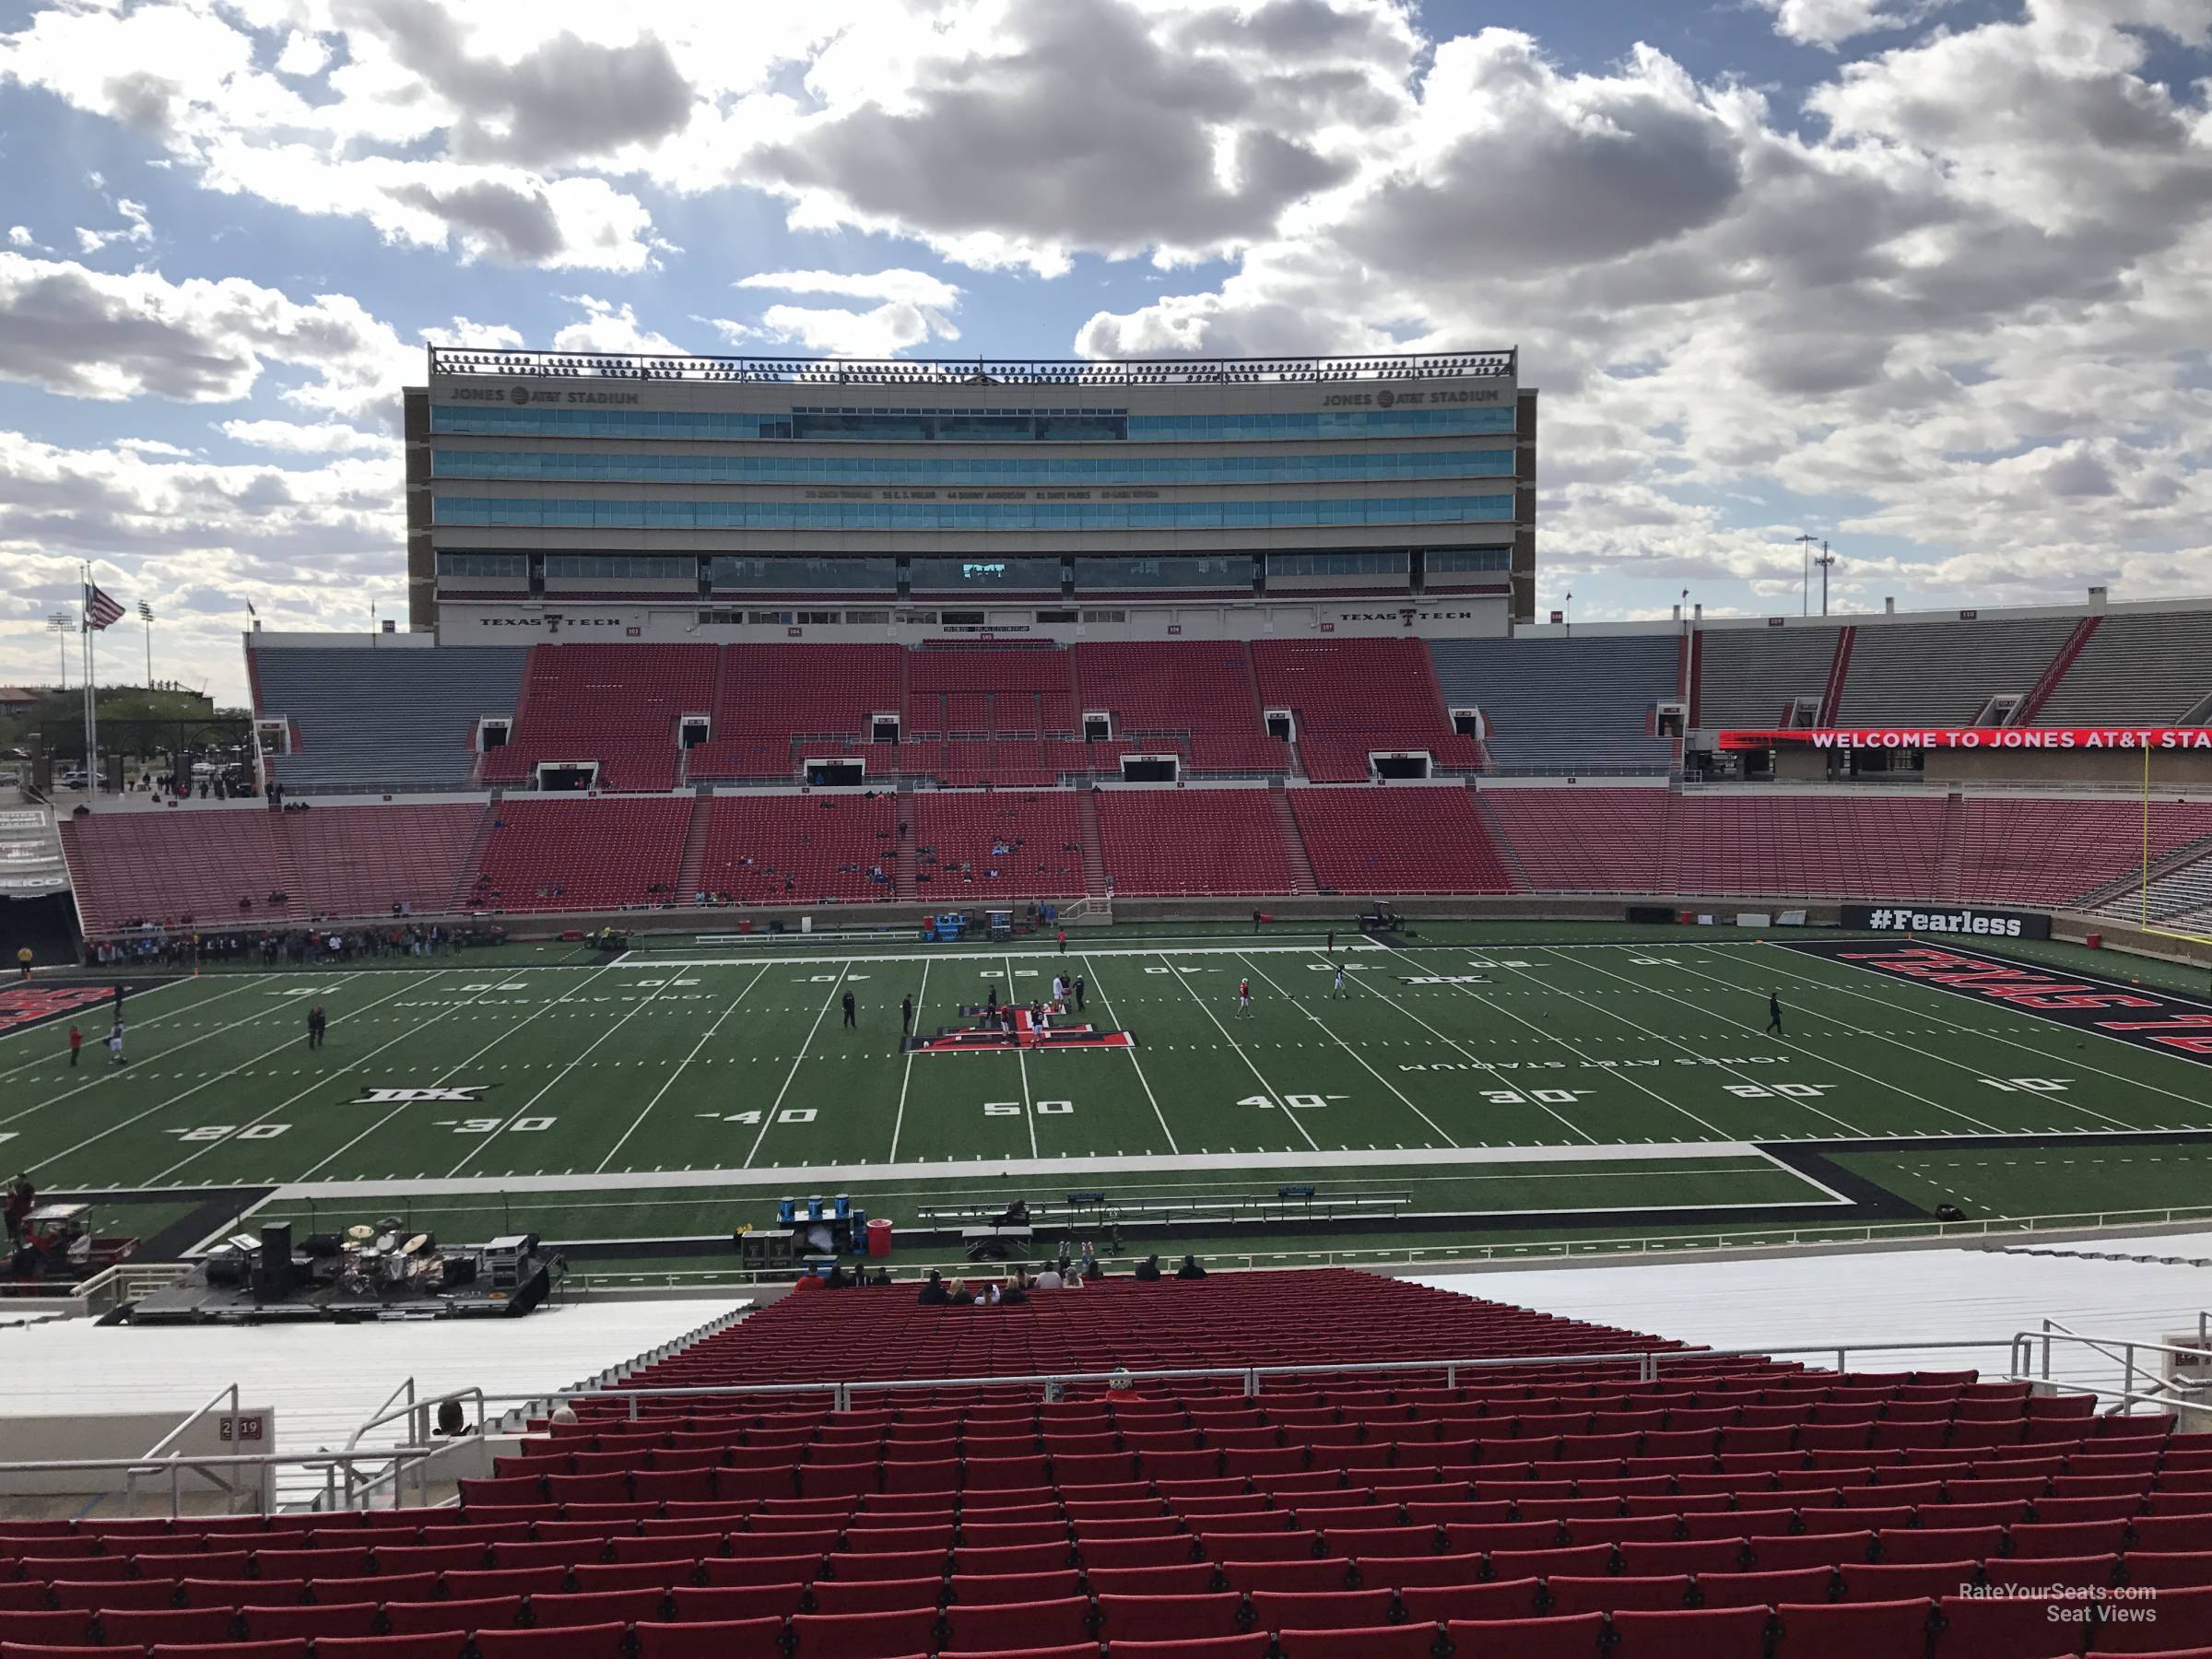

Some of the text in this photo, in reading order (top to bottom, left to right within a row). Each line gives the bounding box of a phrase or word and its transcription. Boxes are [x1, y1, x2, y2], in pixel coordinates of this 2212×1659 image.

[451, 388, 504, 401] JONES
[568, 391, 639, 405] STADIUM
[1323, 394, 1371, 406] JONES
[1430, 390, 1498, 403] STADIUM
[1812, 732, 2212, 748] WELCOME TO JONES AT&T STA
[1869, 909, 2021, 936] #Fearless
[1837, 949, 2163, 1008] TEXAS
[1398, 1059, 1567, 1071] STADIUM
[1673, 1056, 1792, 1066] JONES
[1236, 1094, 1327, 1108] 40
[1478, 1088, 1580, 1103] 30
[983, 1100, 1075, 1116] 50
[453, 1116, 558, 1133] 30
[723, 1109, 818, 1124] 40
[178, 1124, 292, 1141] 20
